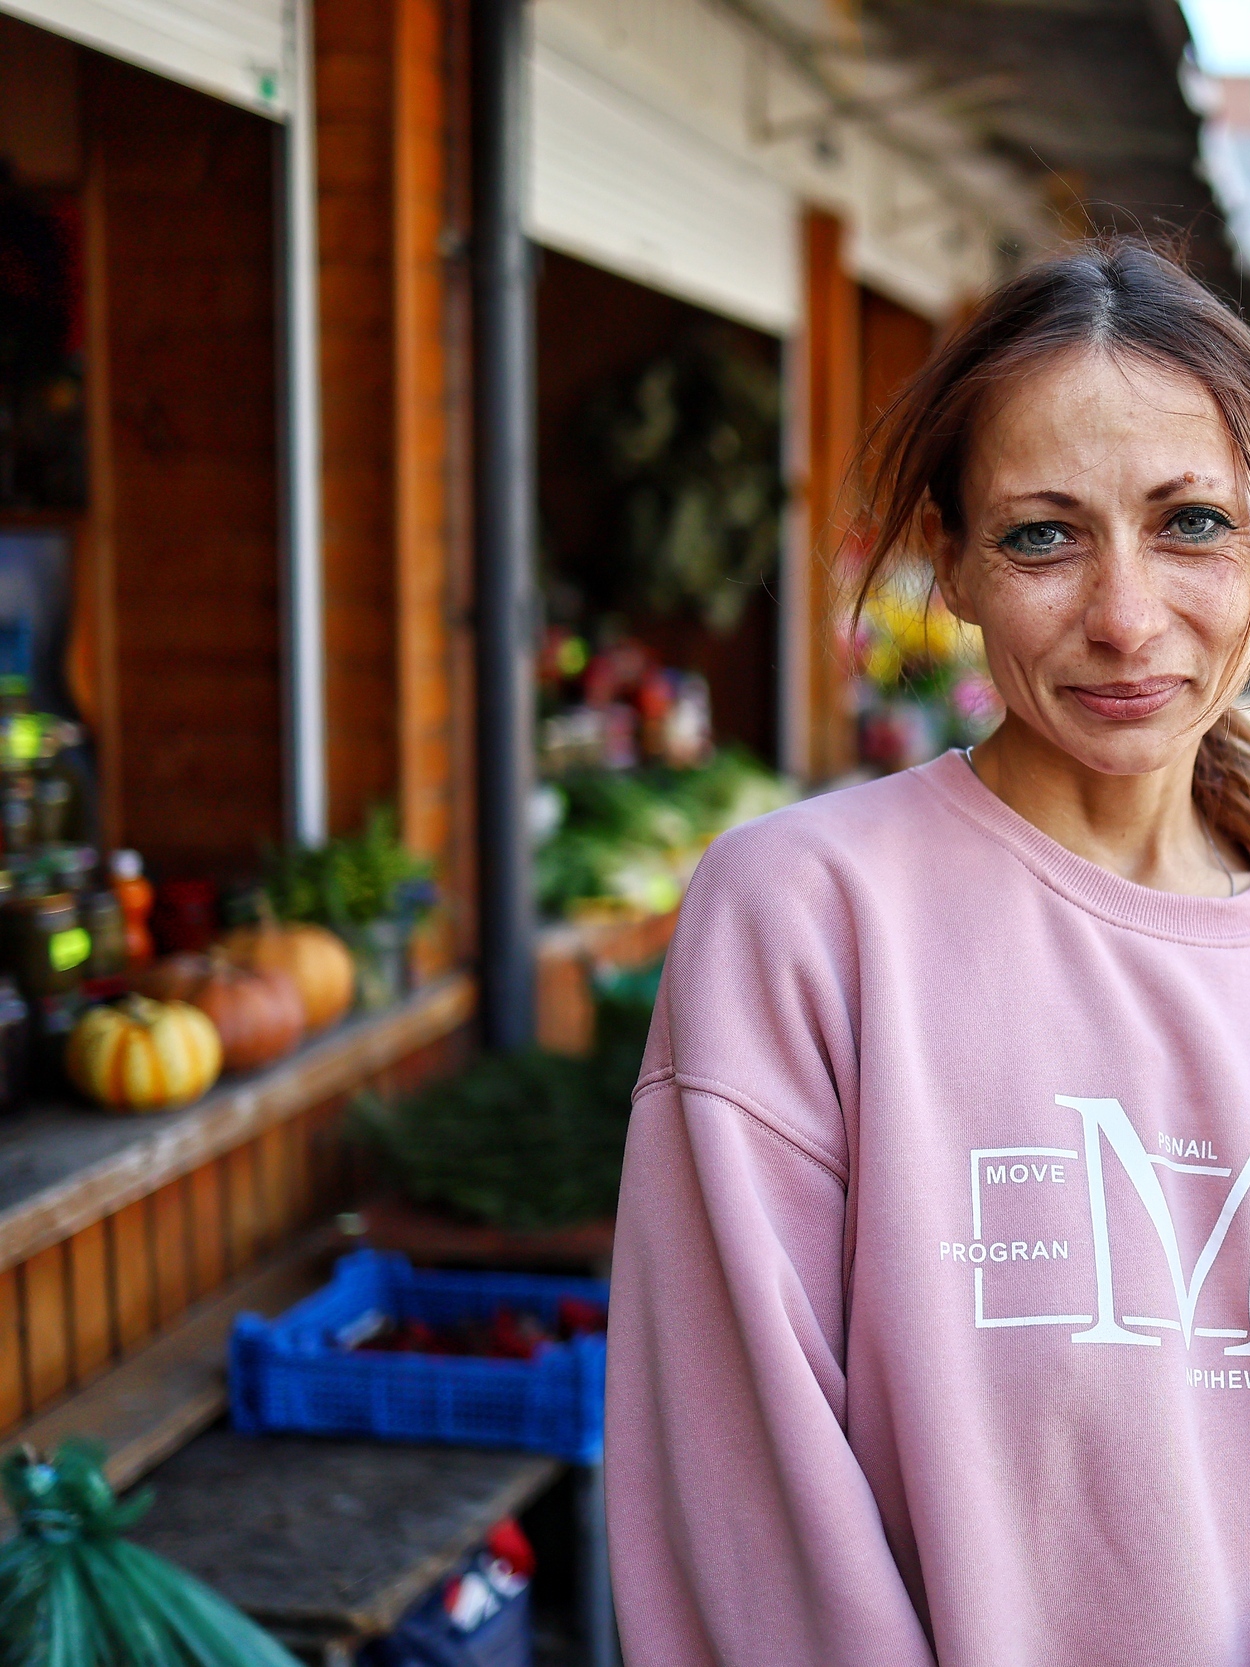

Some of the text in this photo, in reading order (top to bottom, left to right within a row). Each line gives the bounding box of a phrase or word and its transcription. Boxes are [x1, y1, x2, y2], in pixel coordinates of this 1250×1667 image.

[1157, 1131, 1218, 1160] PSNAIL
[986, 1163, 1066, 1185] MOVE
[939, 1240, 1069, 1263] PROGRAN
